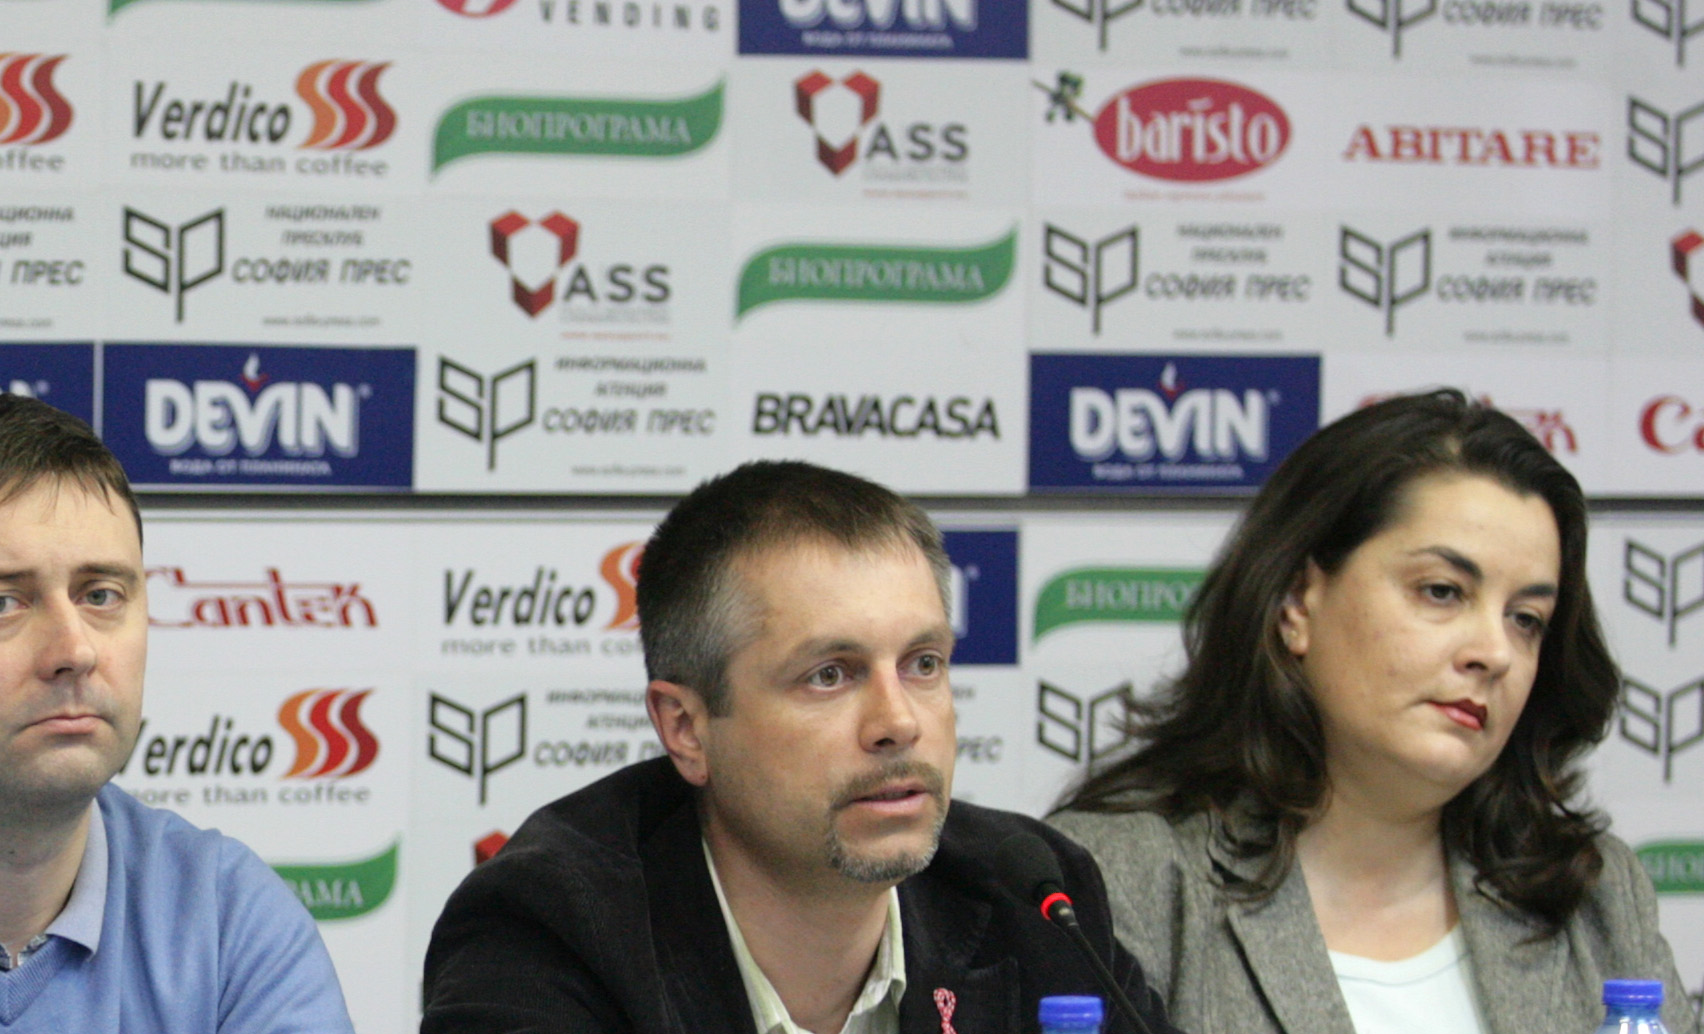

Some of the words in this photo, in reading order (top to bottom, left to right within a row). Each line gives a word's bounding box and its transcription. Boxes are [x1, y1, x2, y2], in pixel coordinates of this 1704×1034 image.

[133, 81, 292, 143] Verdico
[466, 108, 692, 144] БИОПРОГРАМА
[130, 152, 208, 171] more
[220, 151, 286, 173] than
[295, 152, 389, 176] coffee
[1342, 124, 1600, 171] ABITARE
[11, 259, 85, 286] ПРЕС
[232, 257, 330, 285] СОФИЯ
[340, 258, 412, 286] ПРЕС
[144, 379, 360, 457] DEVIN
[543, 408, 637, 436] СОФИЯ
[646, 409, 716, 436] ПРЕС
[752, 392, 1001, 440] BRAVACASA
[1069, 387, 1268, 460] DEVIN
[443, 566, 596, 627] Verdico
[527, 634, 592, 655] than
[203, 784, 269, 805] than
[278, 780, 371, 806] coffee
